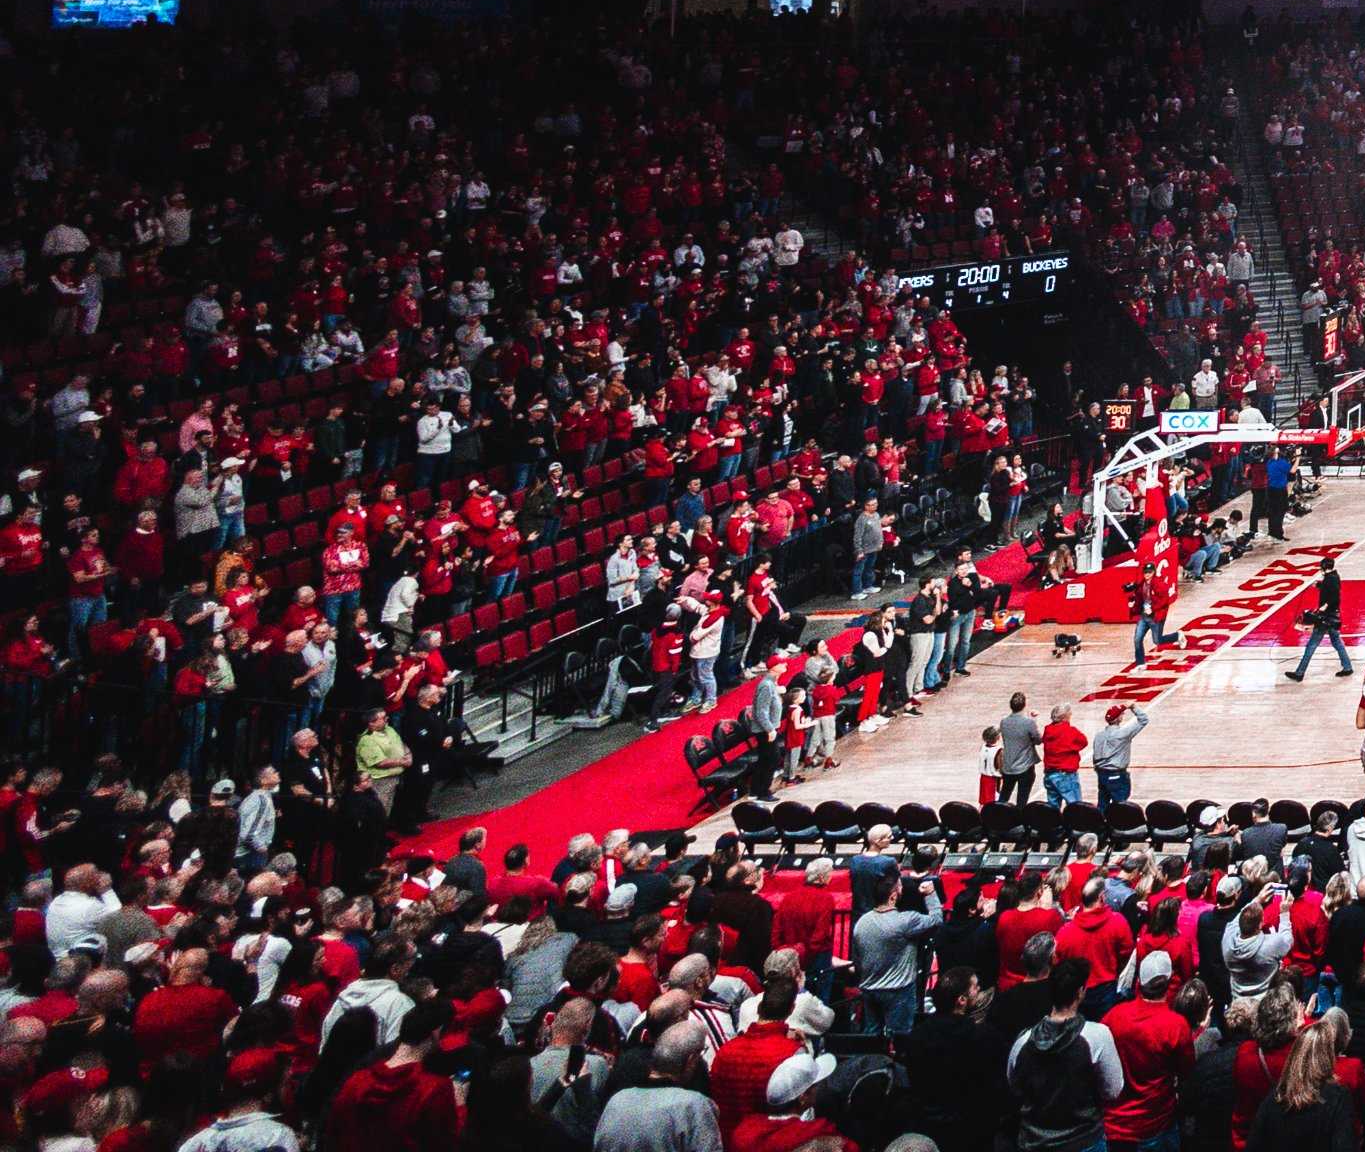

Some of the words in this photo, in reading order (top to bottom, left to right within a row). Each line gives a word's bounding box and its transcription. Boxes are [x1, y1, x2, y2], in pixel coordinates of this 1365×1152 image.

[1023, 258, 1068, 273] BUCKEYES
[958, 263, 1000, 286] 20:00
[1104, 404, 1133, 415] 20:00
[1110, 415, 1127, 430] 30
[1168, 414, 1210, 429] COX
[1079, 542, 1356, 703] NEBRASKA
